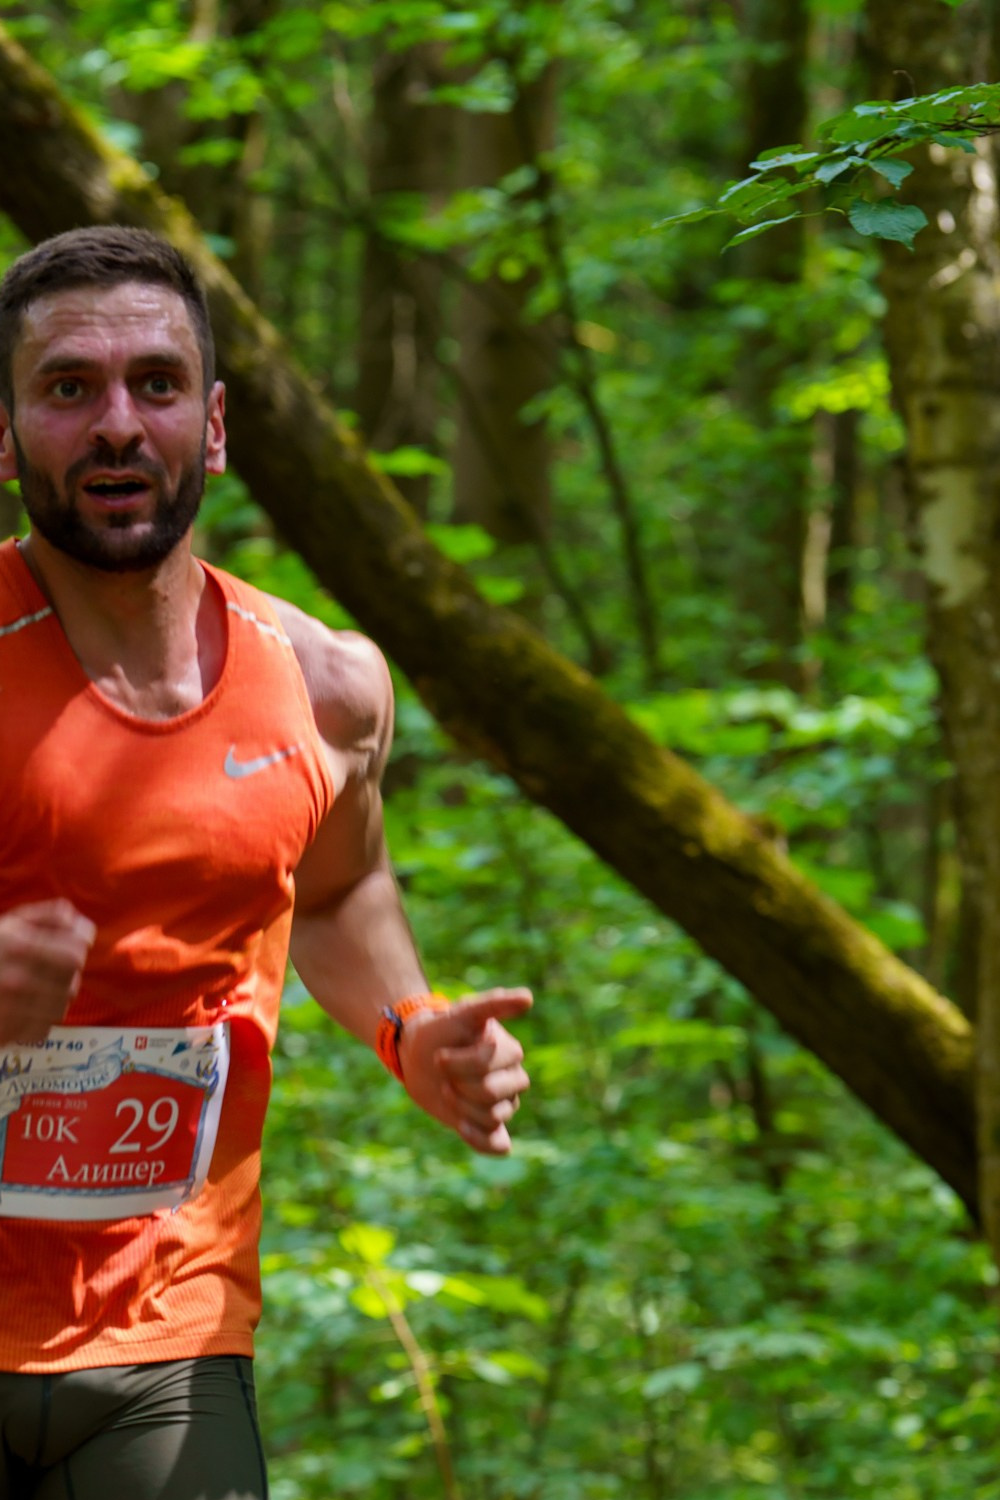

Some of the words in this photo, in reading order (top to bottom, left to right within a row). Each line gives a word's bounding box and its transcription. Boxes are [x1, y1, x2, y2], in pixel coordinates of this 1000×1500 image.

[66, 1040, 84, 1052] 40
[21, 1112, 81, 1144] 10K
[109, 1096, 179, 1155] 29
[46, 1154, 166, 1189] Алишер
